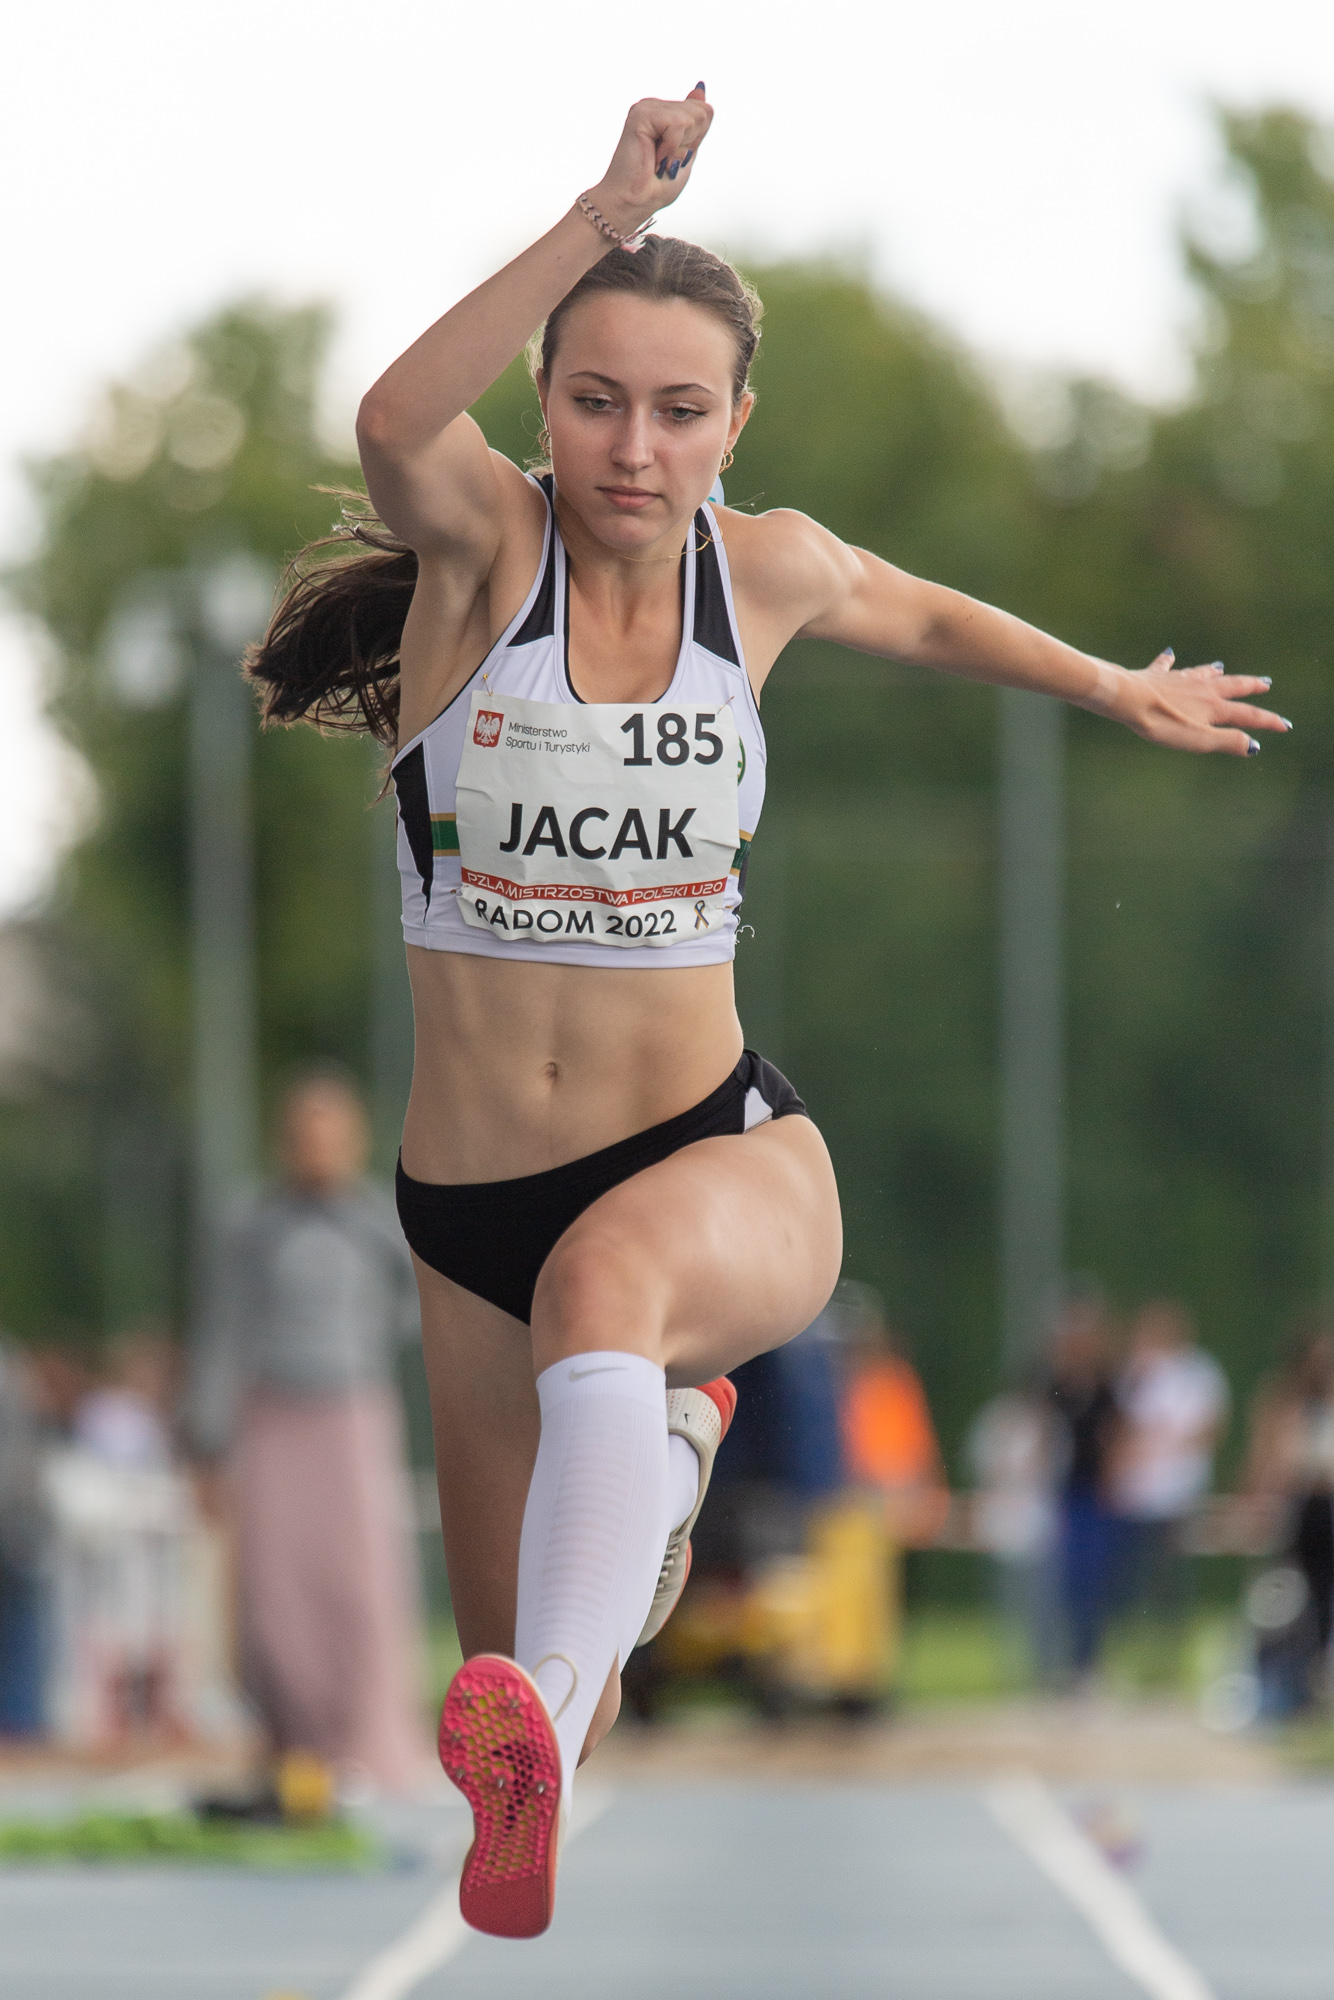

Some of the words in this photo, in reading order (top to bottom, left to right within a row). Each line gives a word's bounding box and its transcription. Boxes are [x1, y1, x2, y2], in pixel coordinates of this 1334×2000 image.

[505, 736, 537, 751] Sportu
[544, 741, 591, 755] Turystyki
[508, 721, 568, 738] Ministerstwo
[620, 712, 724, 767] 185
[499, 802, 698, 861] JACAK
[467, 872, 505, 893] PZLA
[505, 884, 629, 906] MISTRZOSTWA
[632, 886, 688, 902] POLSKI
[691, 881, 723, 896] U20
[475, 898, 595, 934] RADOM
[605, 909, 677, 939] 2022
